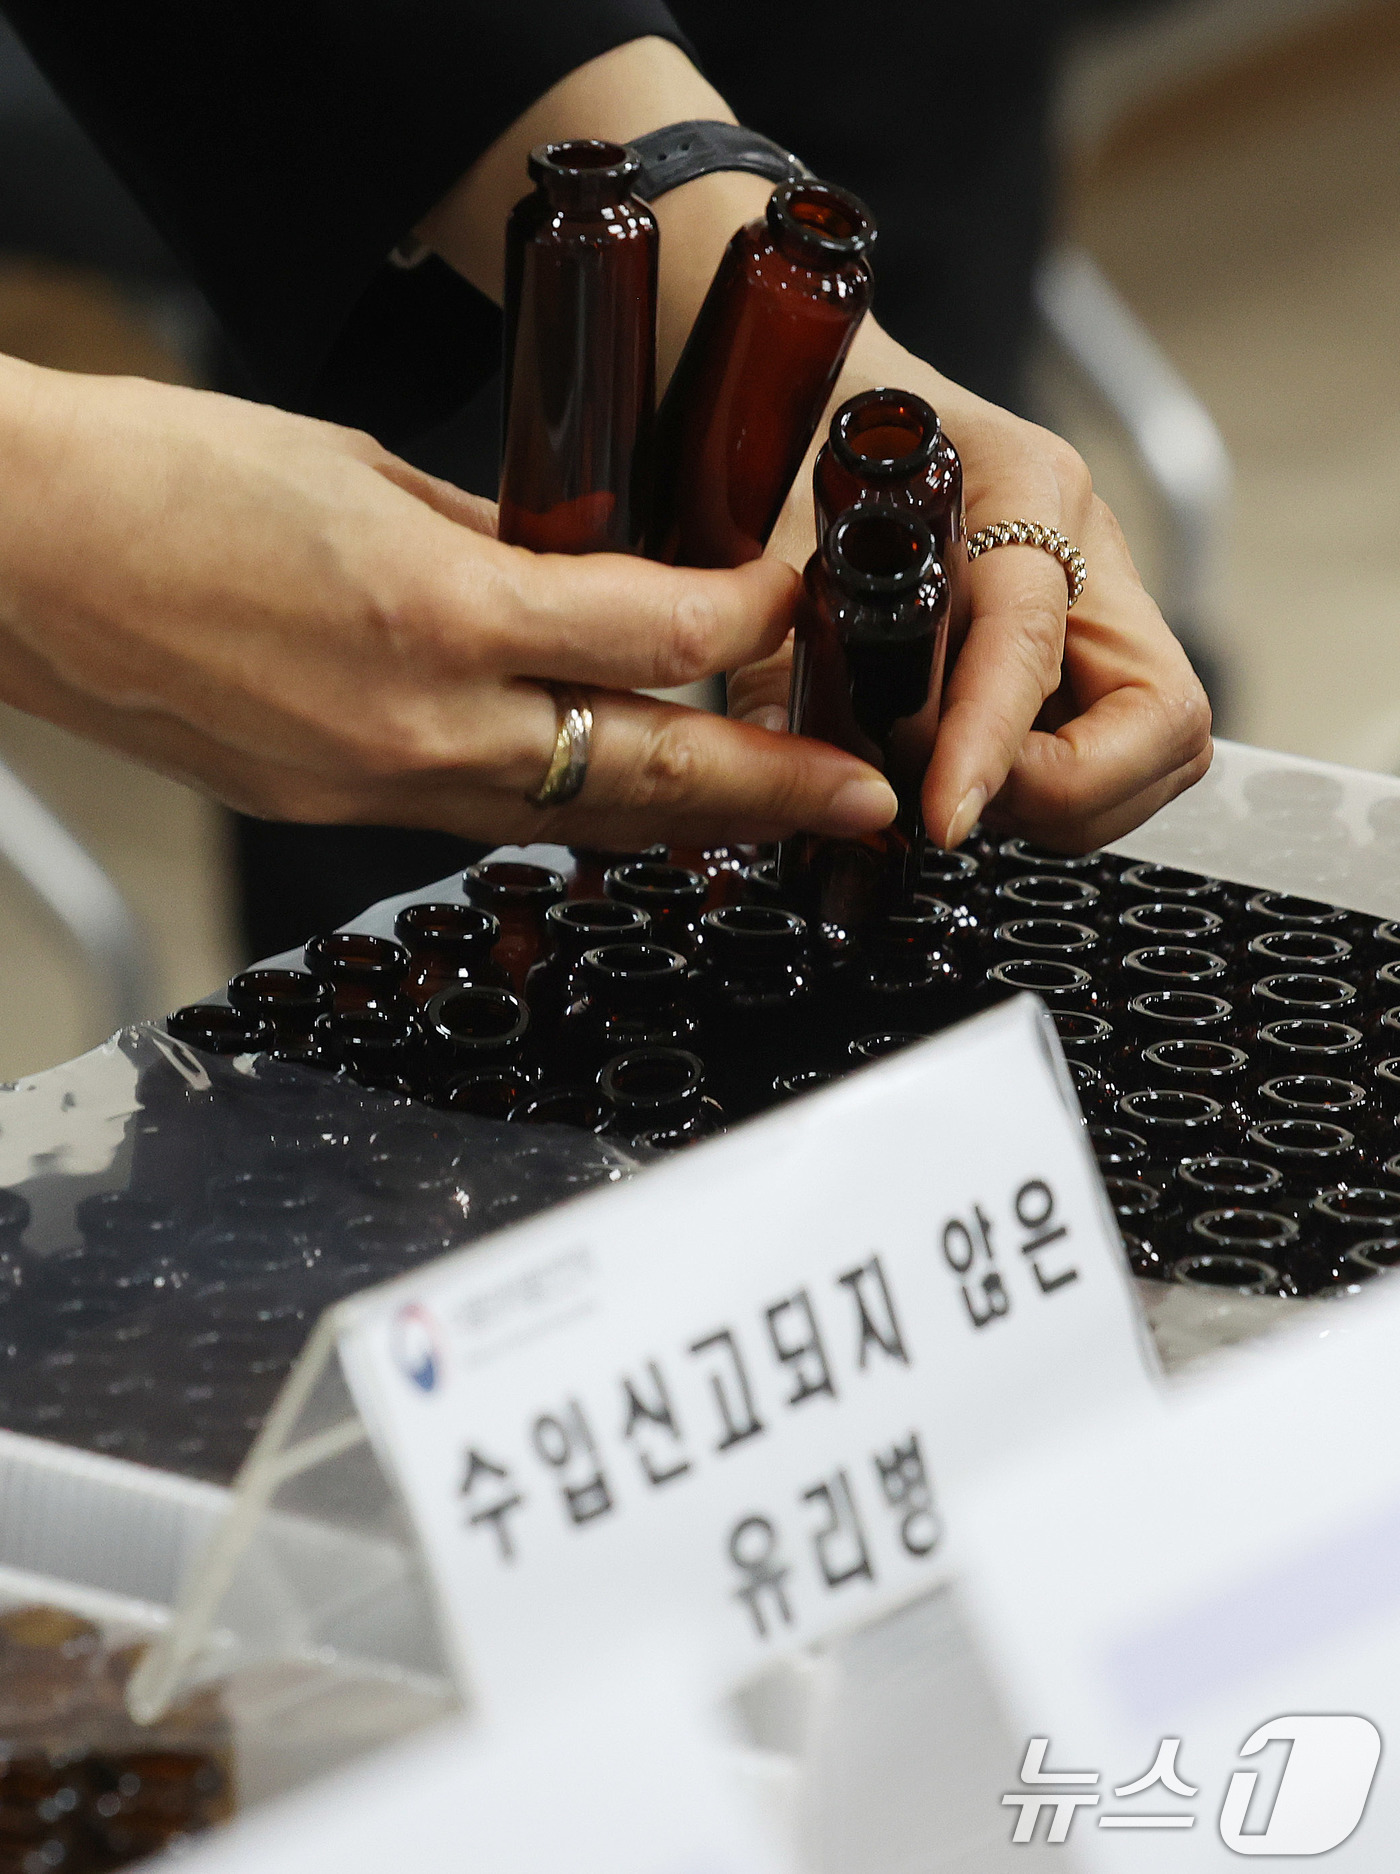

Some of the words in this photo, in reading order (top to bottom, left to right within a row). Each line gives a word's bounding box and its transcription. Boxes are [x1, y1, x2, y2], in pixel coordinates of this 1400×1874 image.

[457, 1252, 911, 1562] 수입신고되지
[939, 1177, 1080, 1330] 않은
[727, 1431, 946, 1639] 유리병
